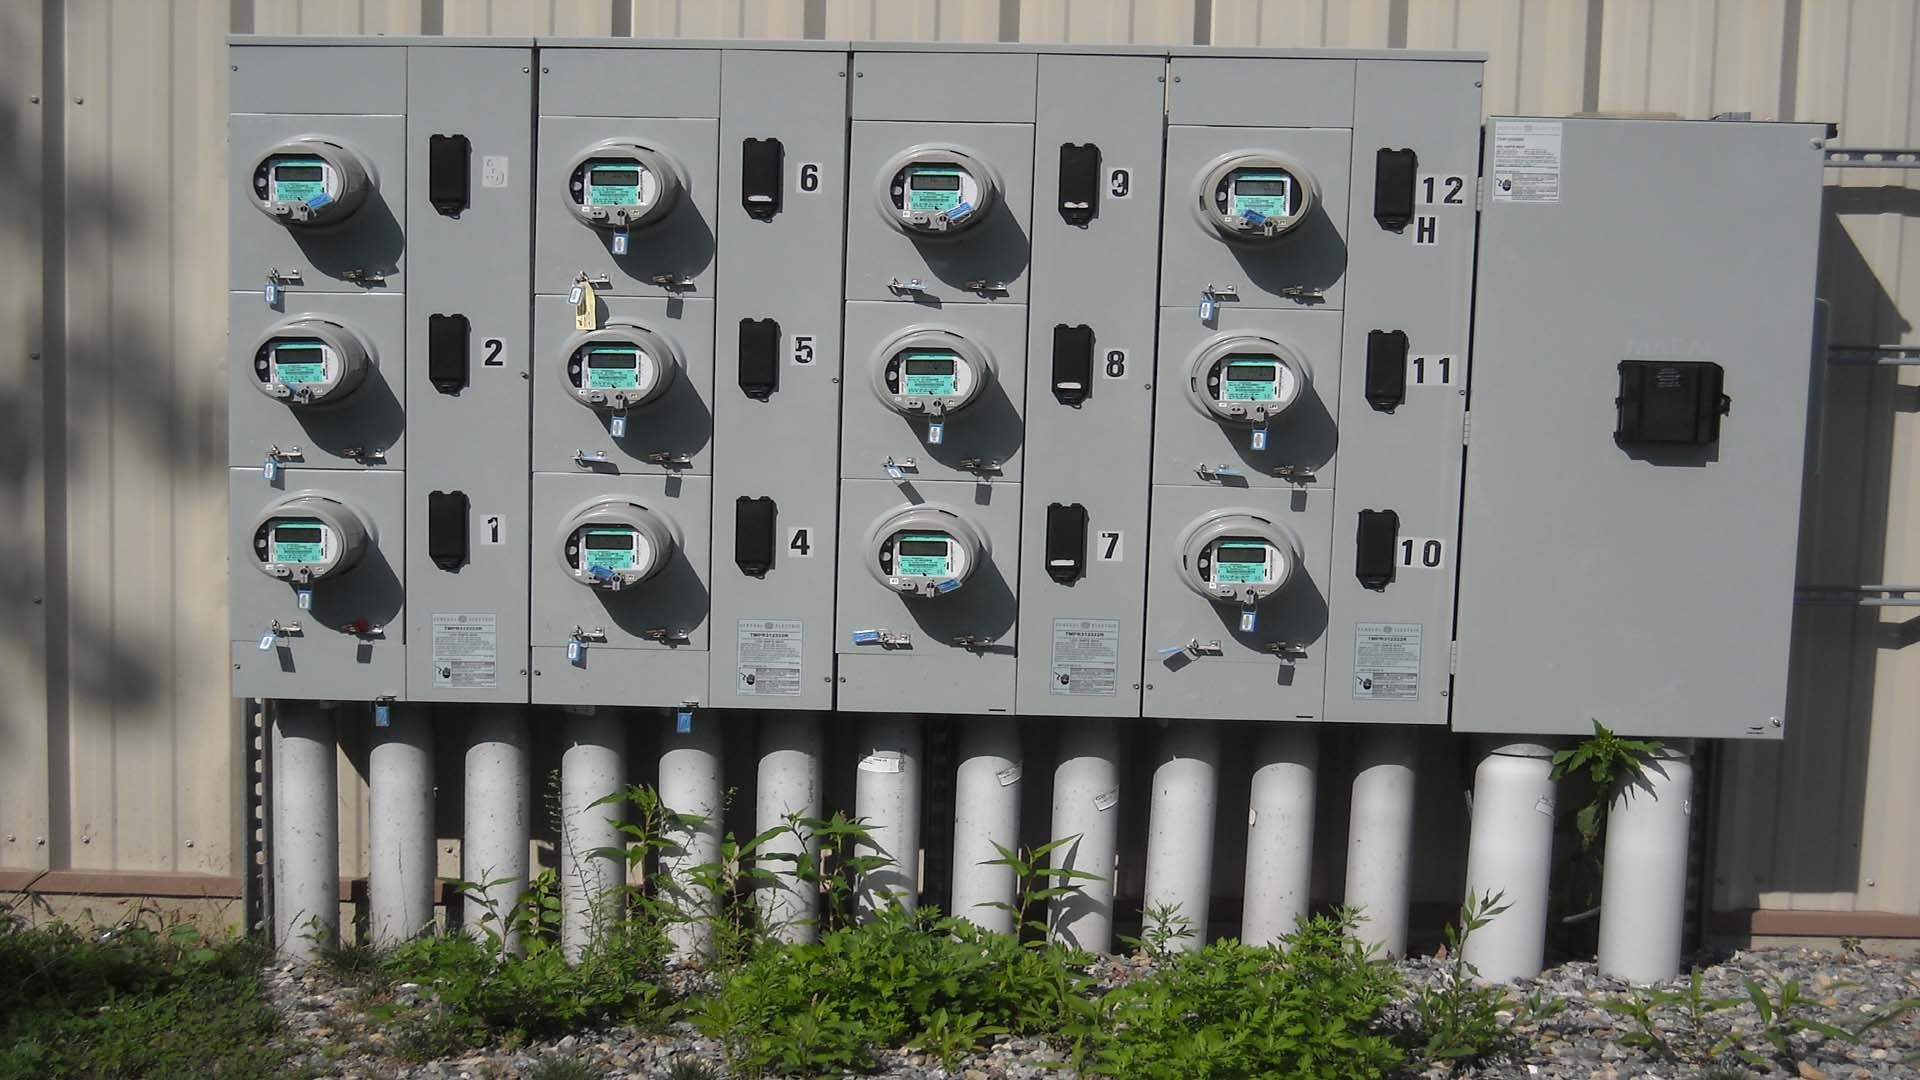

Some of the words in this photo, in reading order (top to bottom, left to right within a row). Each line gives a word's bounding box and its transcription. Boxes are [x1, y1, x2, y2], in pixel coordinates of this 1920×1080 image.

[800, 164, 819, 192] 6
[1111, 169, 1129, 198] 9
[1423, 176, 1463, 204] 12
[1417, 216, 1436, 244] H
[484, 339, 504, 367] 2
[794, 336, 813, 364] 5
[1106, 350, 1125, 378] 8
[1413, 357, 1450, 384] 11
[487, 516, 499, 543] 1
[790, 529, 811, 556] 4
[1101, 532, 1119, 559] 7
[1401, 539, 1442, 568] 10
